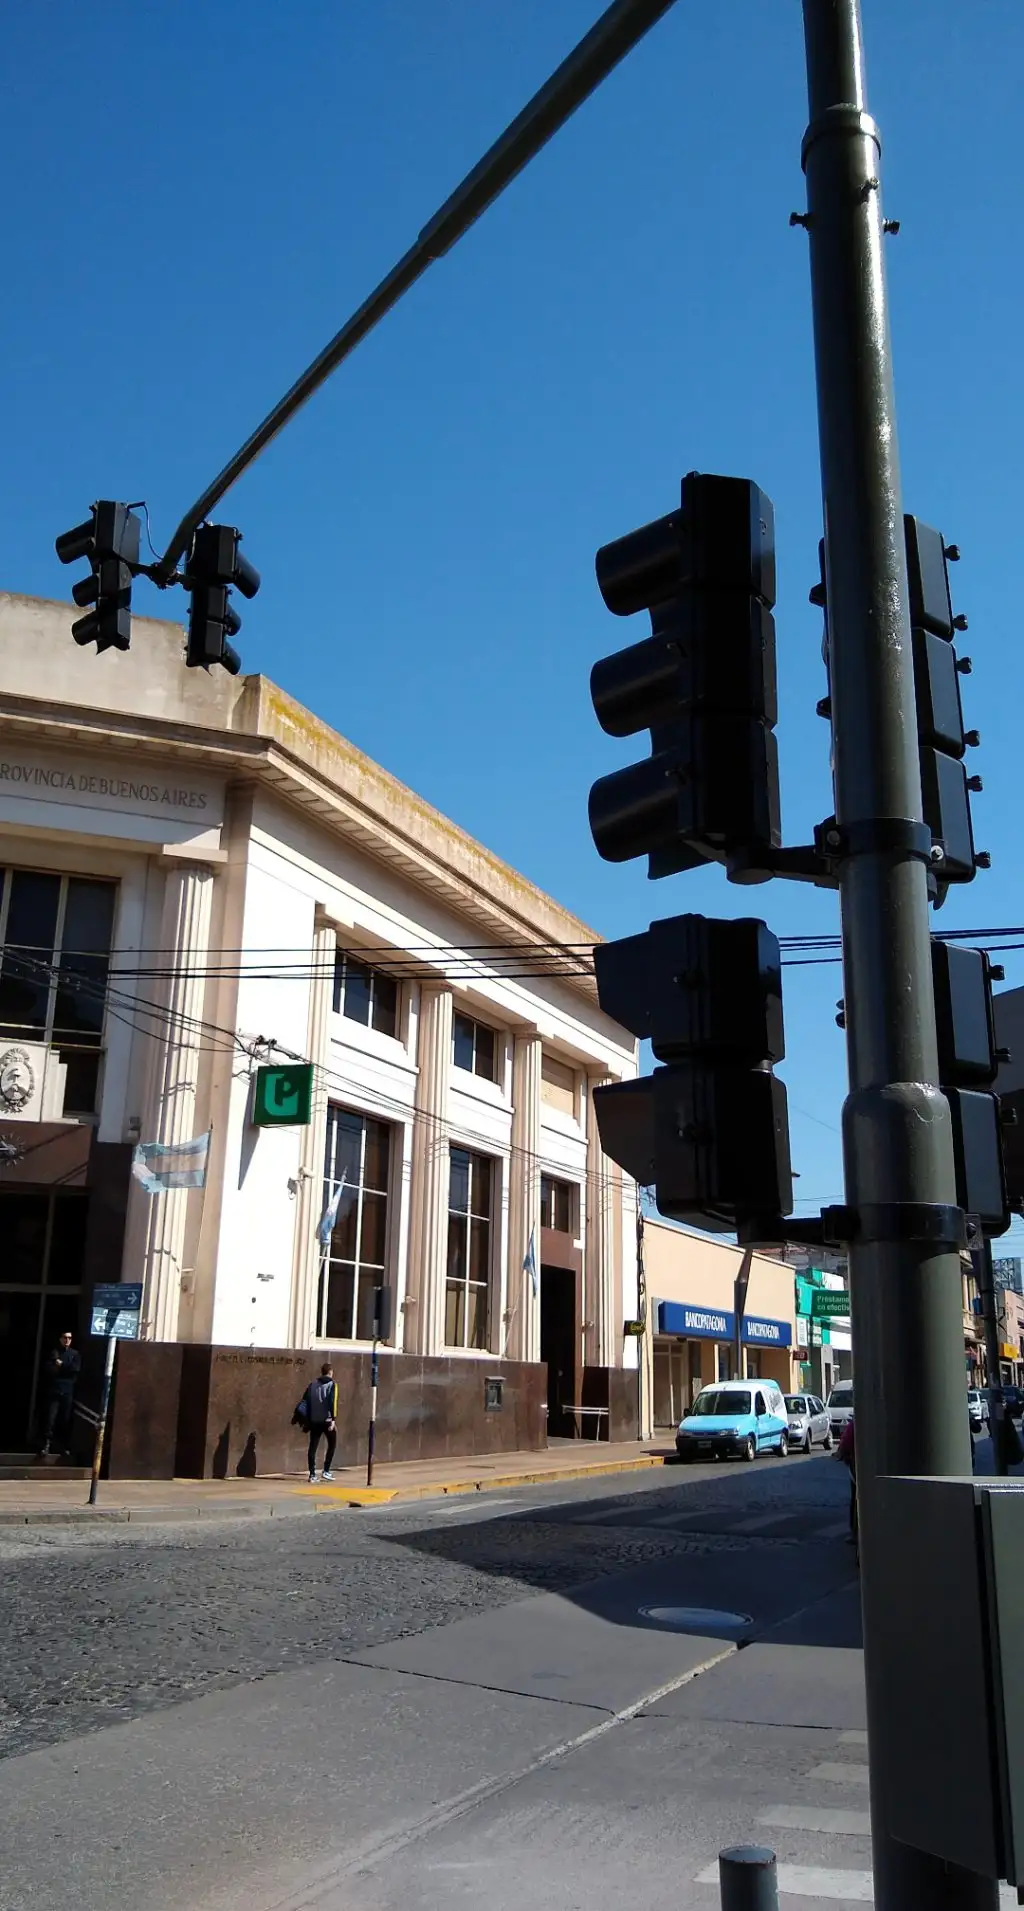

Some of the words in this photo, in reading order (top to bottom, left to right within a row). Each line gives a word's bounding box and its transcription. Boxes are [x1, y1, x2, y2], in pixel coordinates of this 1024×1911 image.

[79, 774, 98, 794] DE
[100, 778, 159, 802] BUENOS
[161, 787, 208, 810] AIRES
